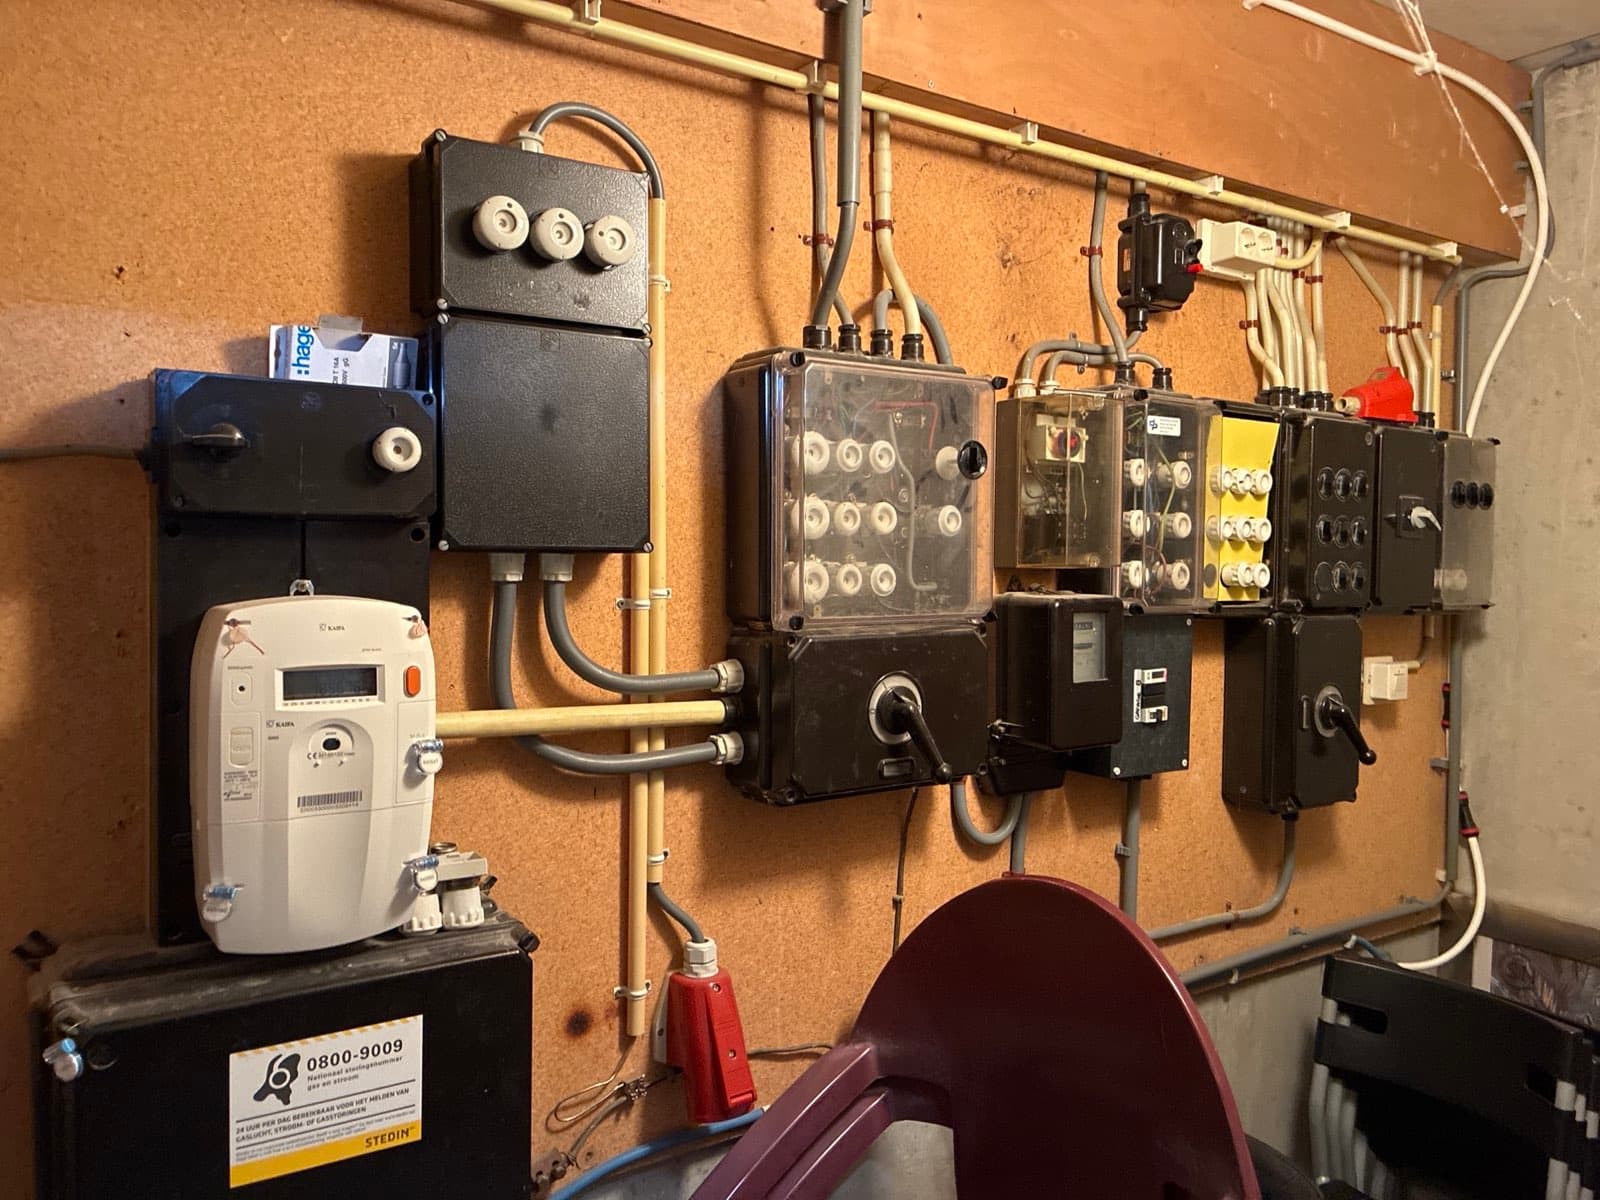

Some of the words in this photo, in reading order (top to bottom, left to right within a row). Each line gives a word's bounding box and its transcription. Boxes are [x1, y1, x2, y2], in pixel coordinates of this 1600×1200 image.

[307, 1038, 402, 1071] 0800-9009
[307, 1068, 342, 1082] Nationaal
[344, 1055, 402, 1074] storingsnummer
[307, 1083, 319, 1091] gas
[333, 1073, 358, 1084] stroom
[236, 1126, 244, 1134] 24
[246, 1122, 260, 1132] UUR
[262, 1118, 275, 1128] PER
[277, 1115, 291, 1124] DAG
[292, 1105, 334, 1121] BEREIKBAAR
[336, 1100, 353, 1110] VOOR
[355, 1097, 367, 1105] HET
[369, 1090, 394, 1102] MELDEN
[396, 1087, 409, 1096] VAN
[236, 1128, 273, 1143] GASLUCHT,
[306, 1118, 314, 1126] OF
[316, 1105, 366, 1123] GASSTORINGEN
[365, 1127, 409, 1148] STEDIN
